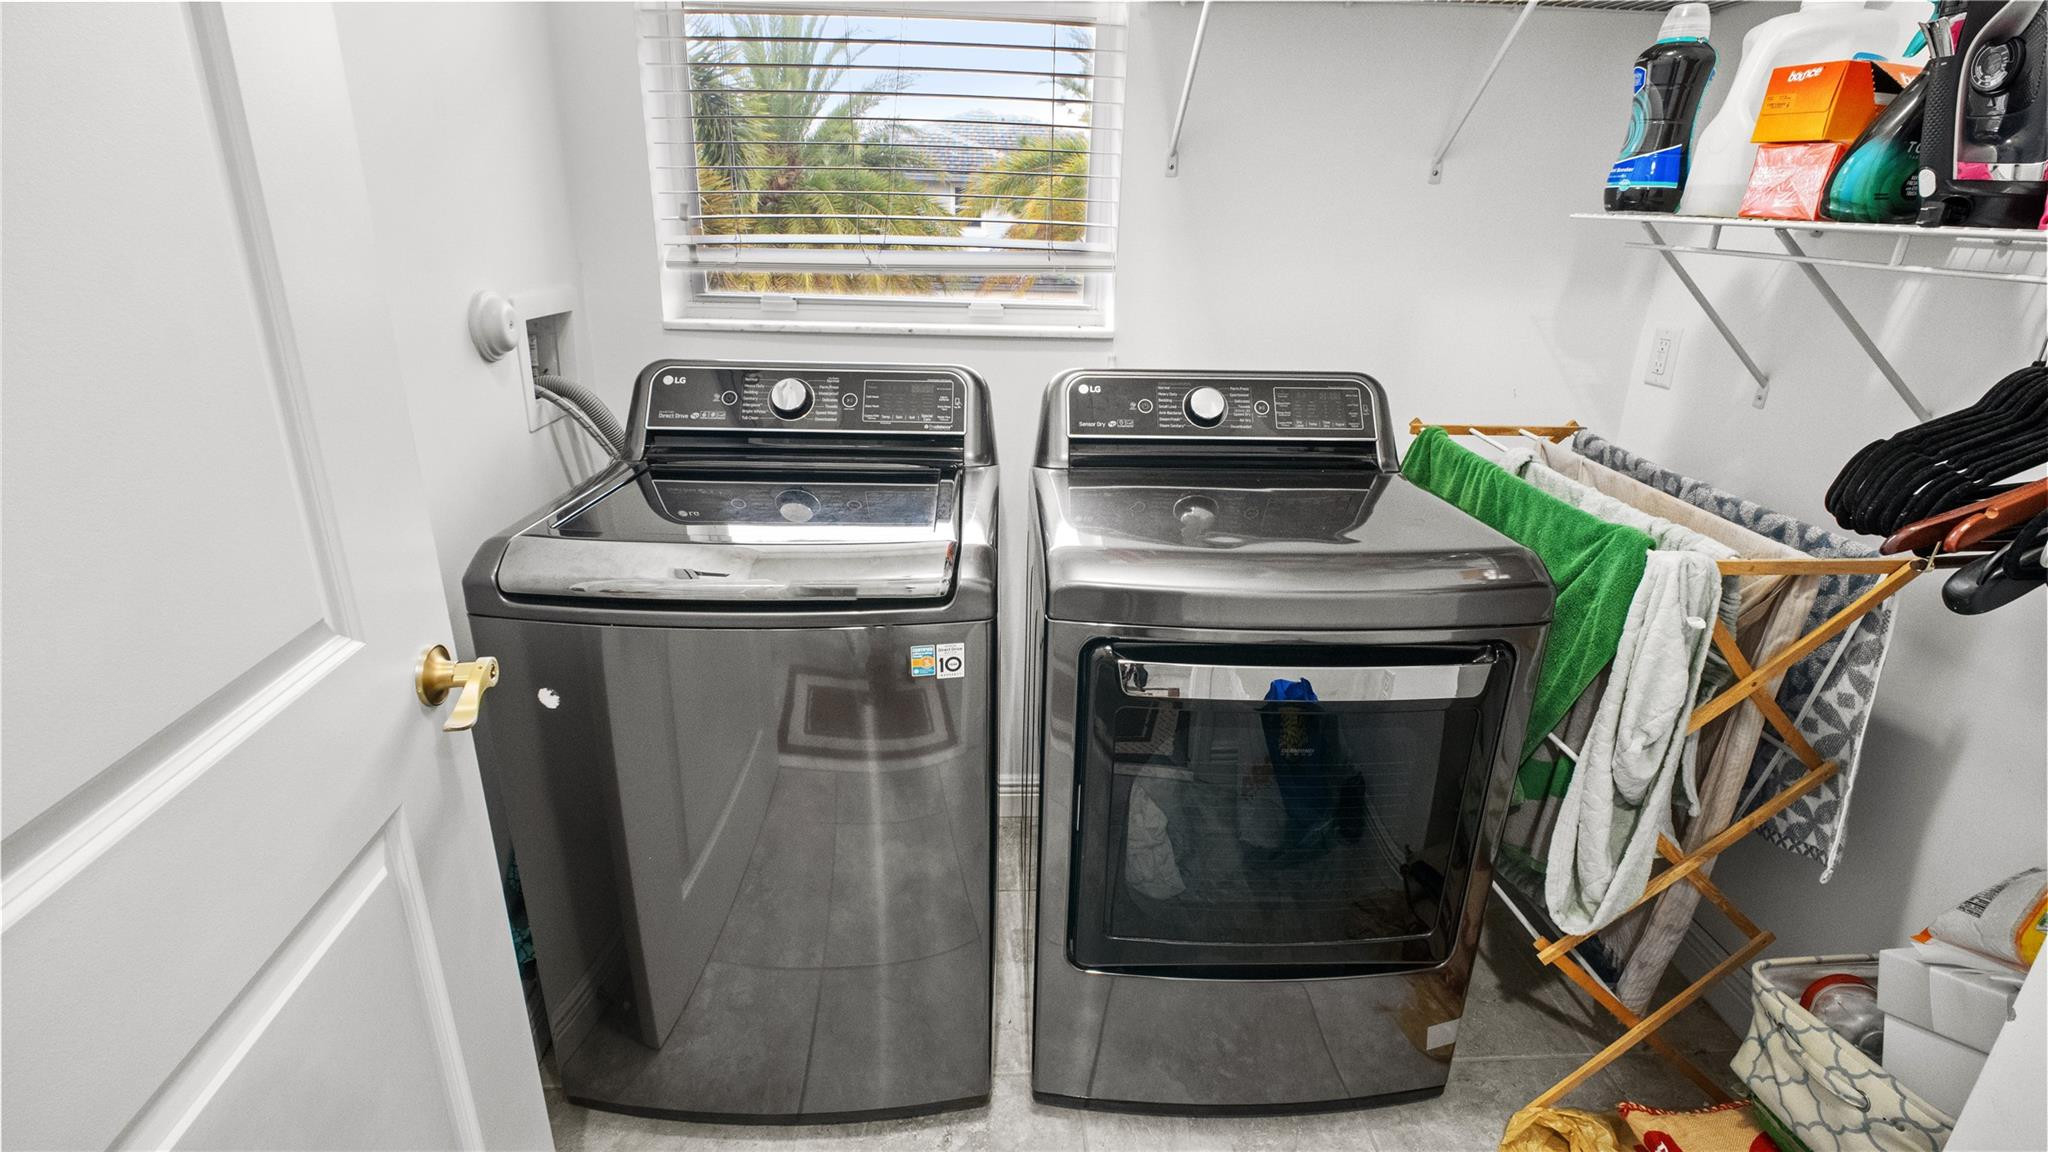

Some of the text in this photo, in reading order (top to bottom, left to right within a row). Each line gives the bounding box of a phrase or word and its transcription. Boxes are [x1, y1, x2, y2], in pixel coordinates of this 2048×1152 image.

[1787, 67, 1823, 82] bounce
[674, 376, 686, 385] LG
[1089, 385, 1101, 393] LG
[940, 657, 962, 672] 10
